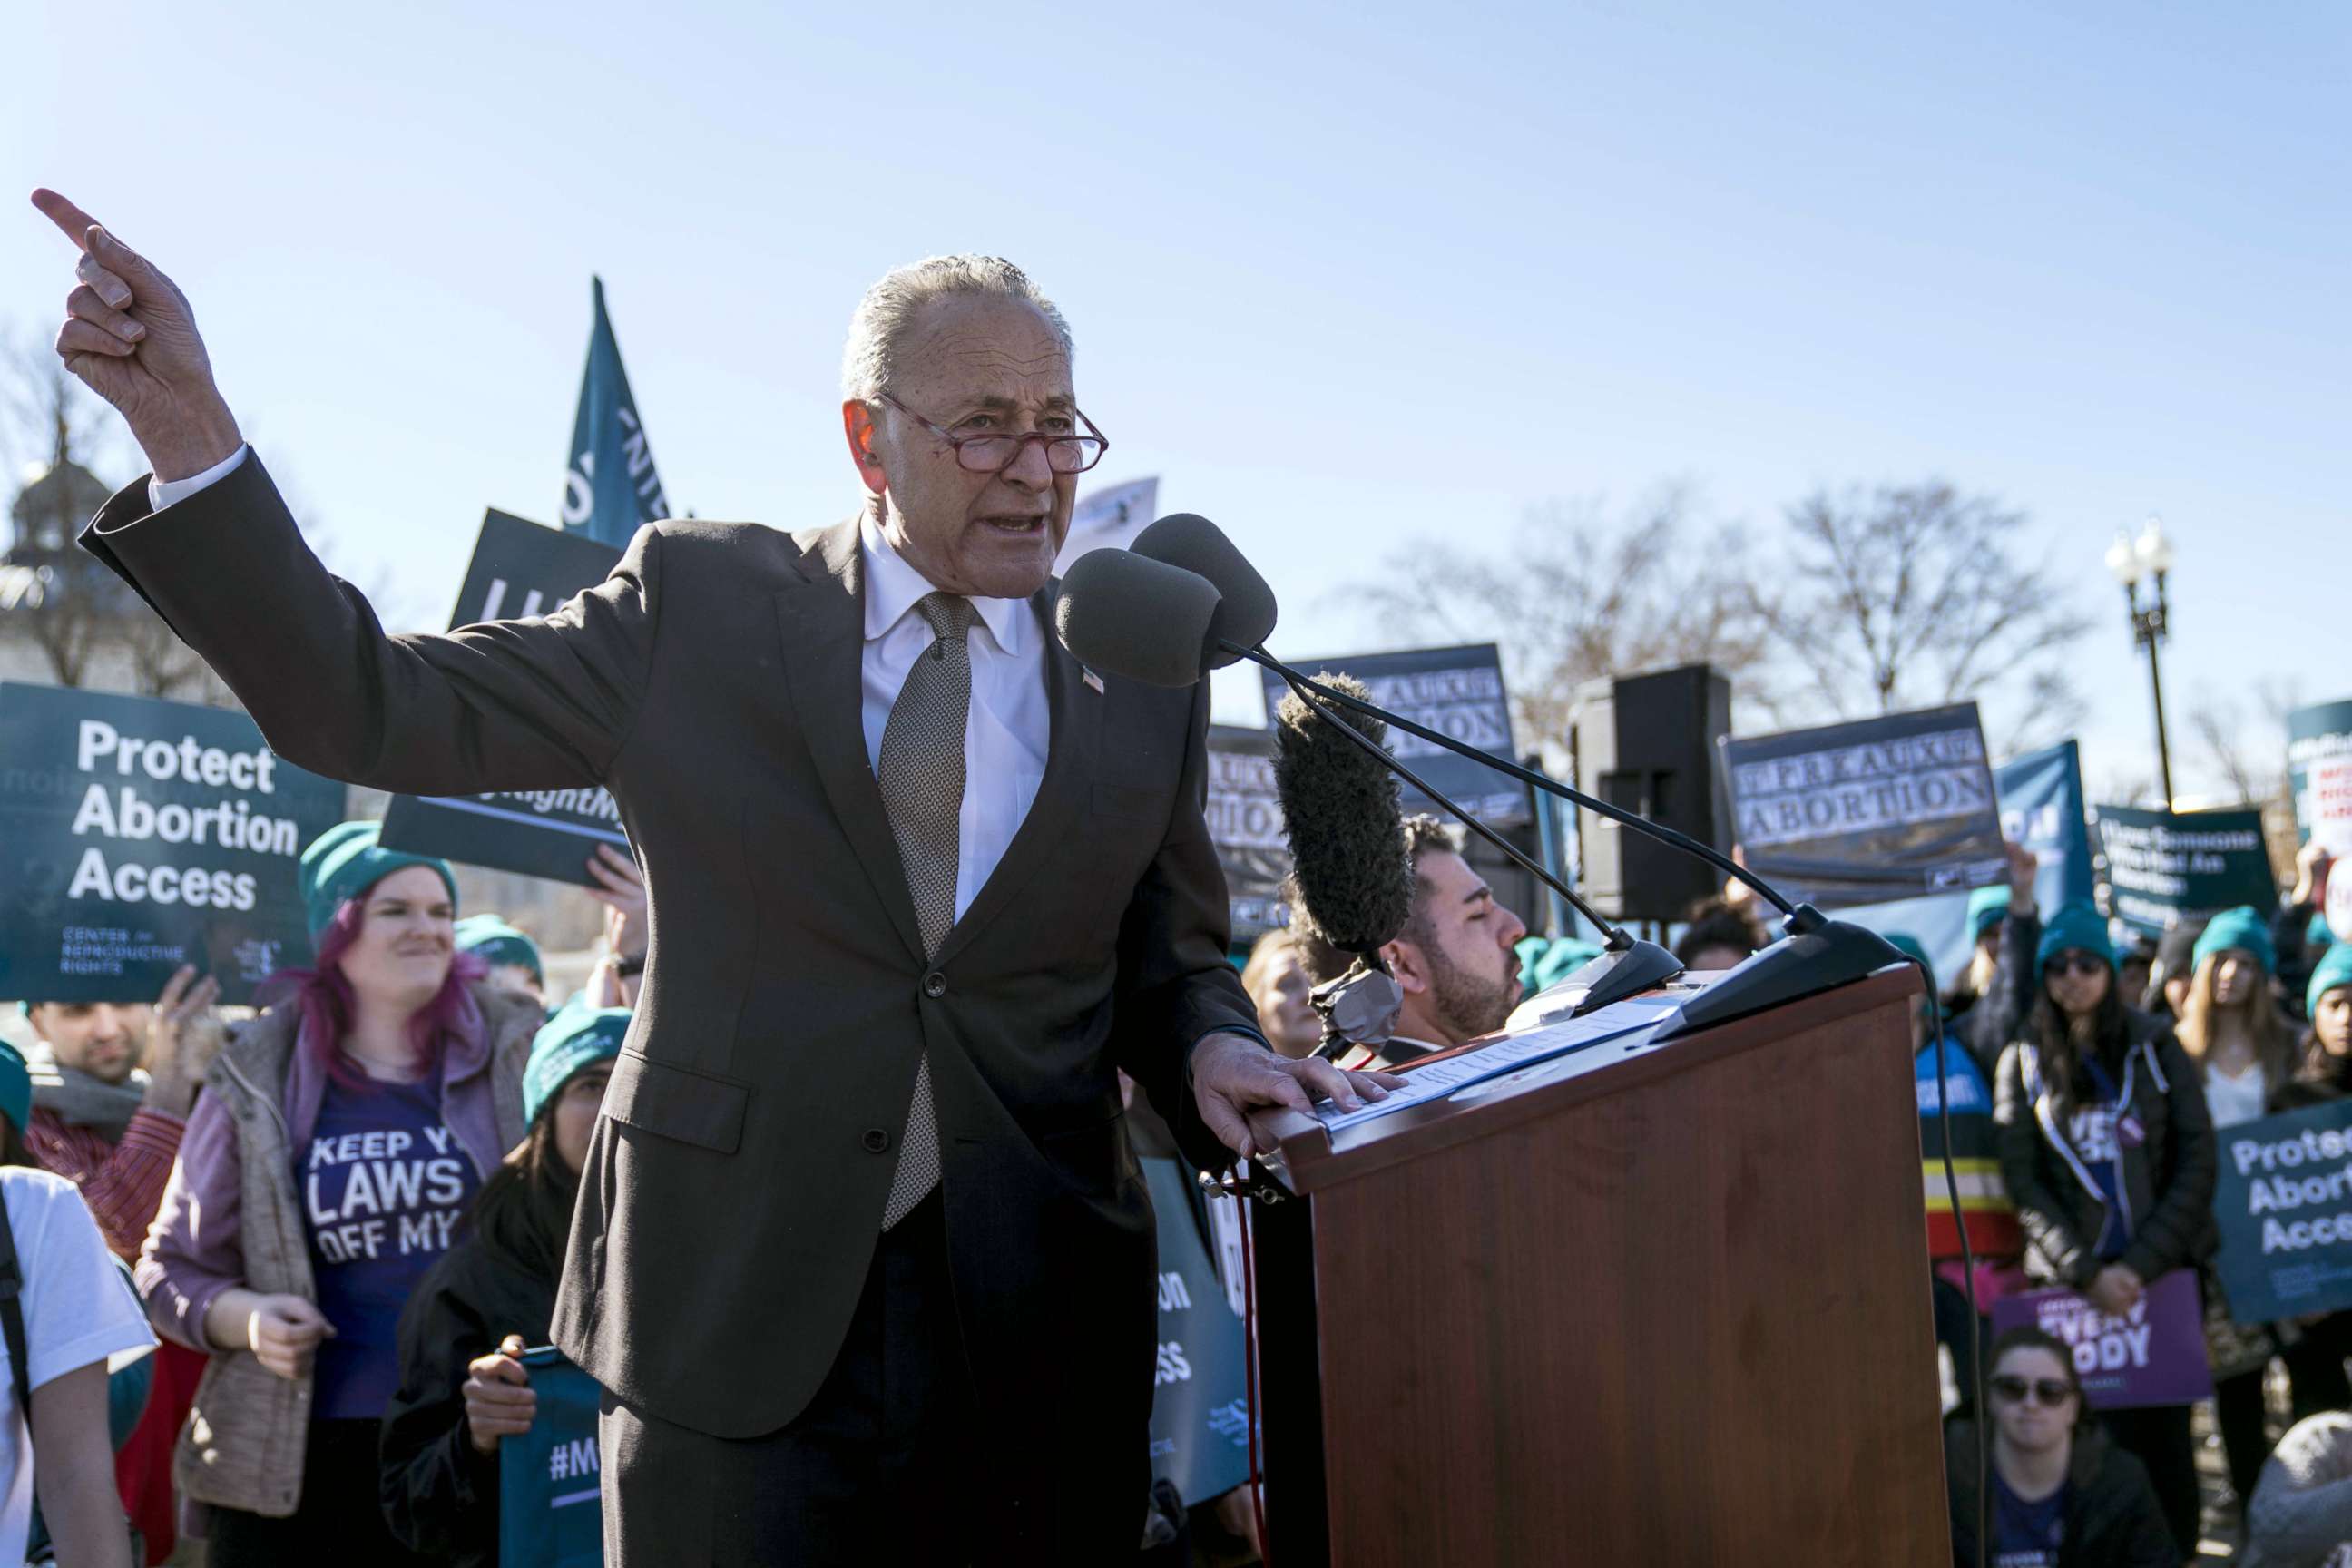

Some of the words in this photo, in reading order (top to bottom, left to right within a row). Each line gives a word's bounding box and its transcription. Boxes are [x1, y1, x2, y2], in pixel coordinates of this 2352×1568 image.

[77, 720, 276, 793] Protect
[72, 783, 299, 857] Abortion
[1746, 772, 1987, 838] ABORTION
[68, 848, 257, 911] Access
[61, 926, 130, 945] CENTER
[309, 1128, 413, 1171] KEEP
[307, 1158, 464, 1227] LAWS
[317, 1219, 387, 1265] OFF
[397, 1209, 462, 1256] MY
